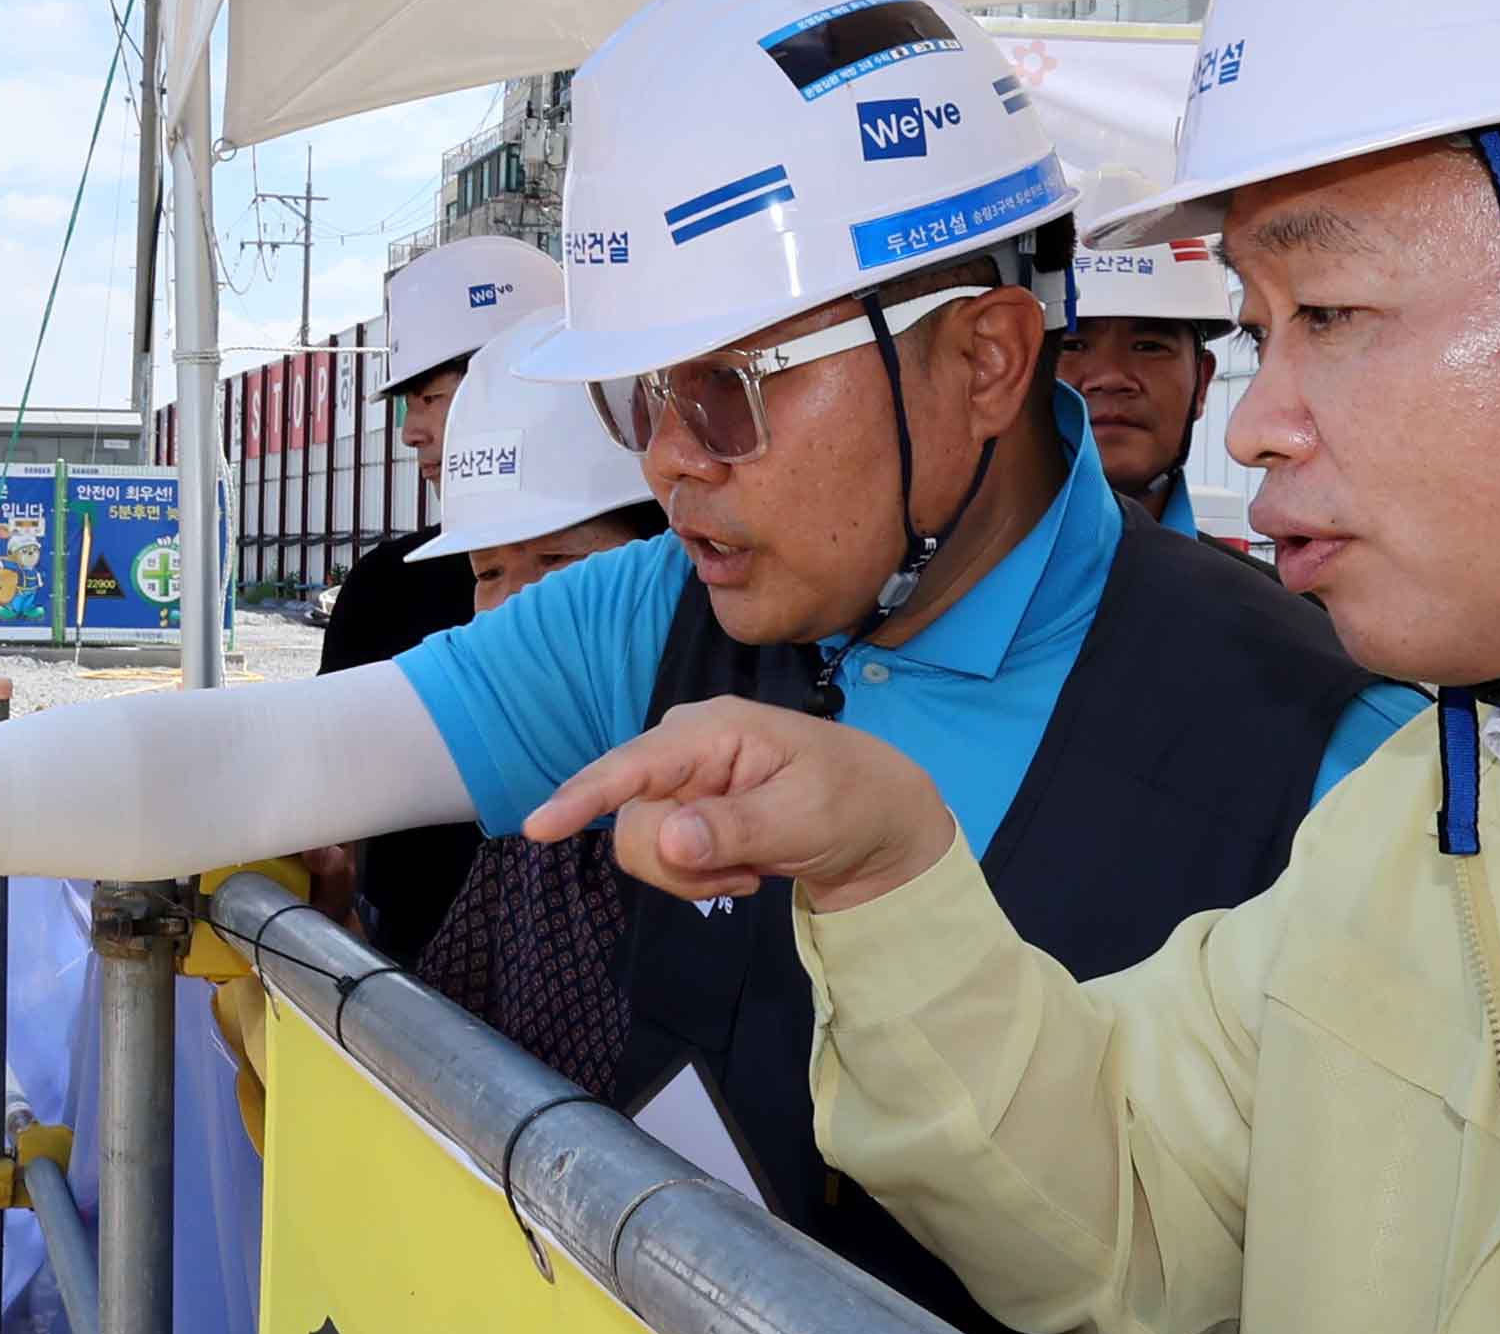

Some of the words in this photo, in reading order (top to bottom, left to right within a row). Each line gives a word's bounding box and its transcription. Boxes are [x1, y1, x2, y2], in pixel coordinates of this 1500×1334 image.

[862, 102, 961, 149] We've
[887, 212, 969, 255] 두산건설
[1074, 255, 1155, 276] 두산건설
[447, 445, 518, 480] 두산건설
[76, 484, 120, 501] 안전이
[125, 485, 173, 503] 최우선!
